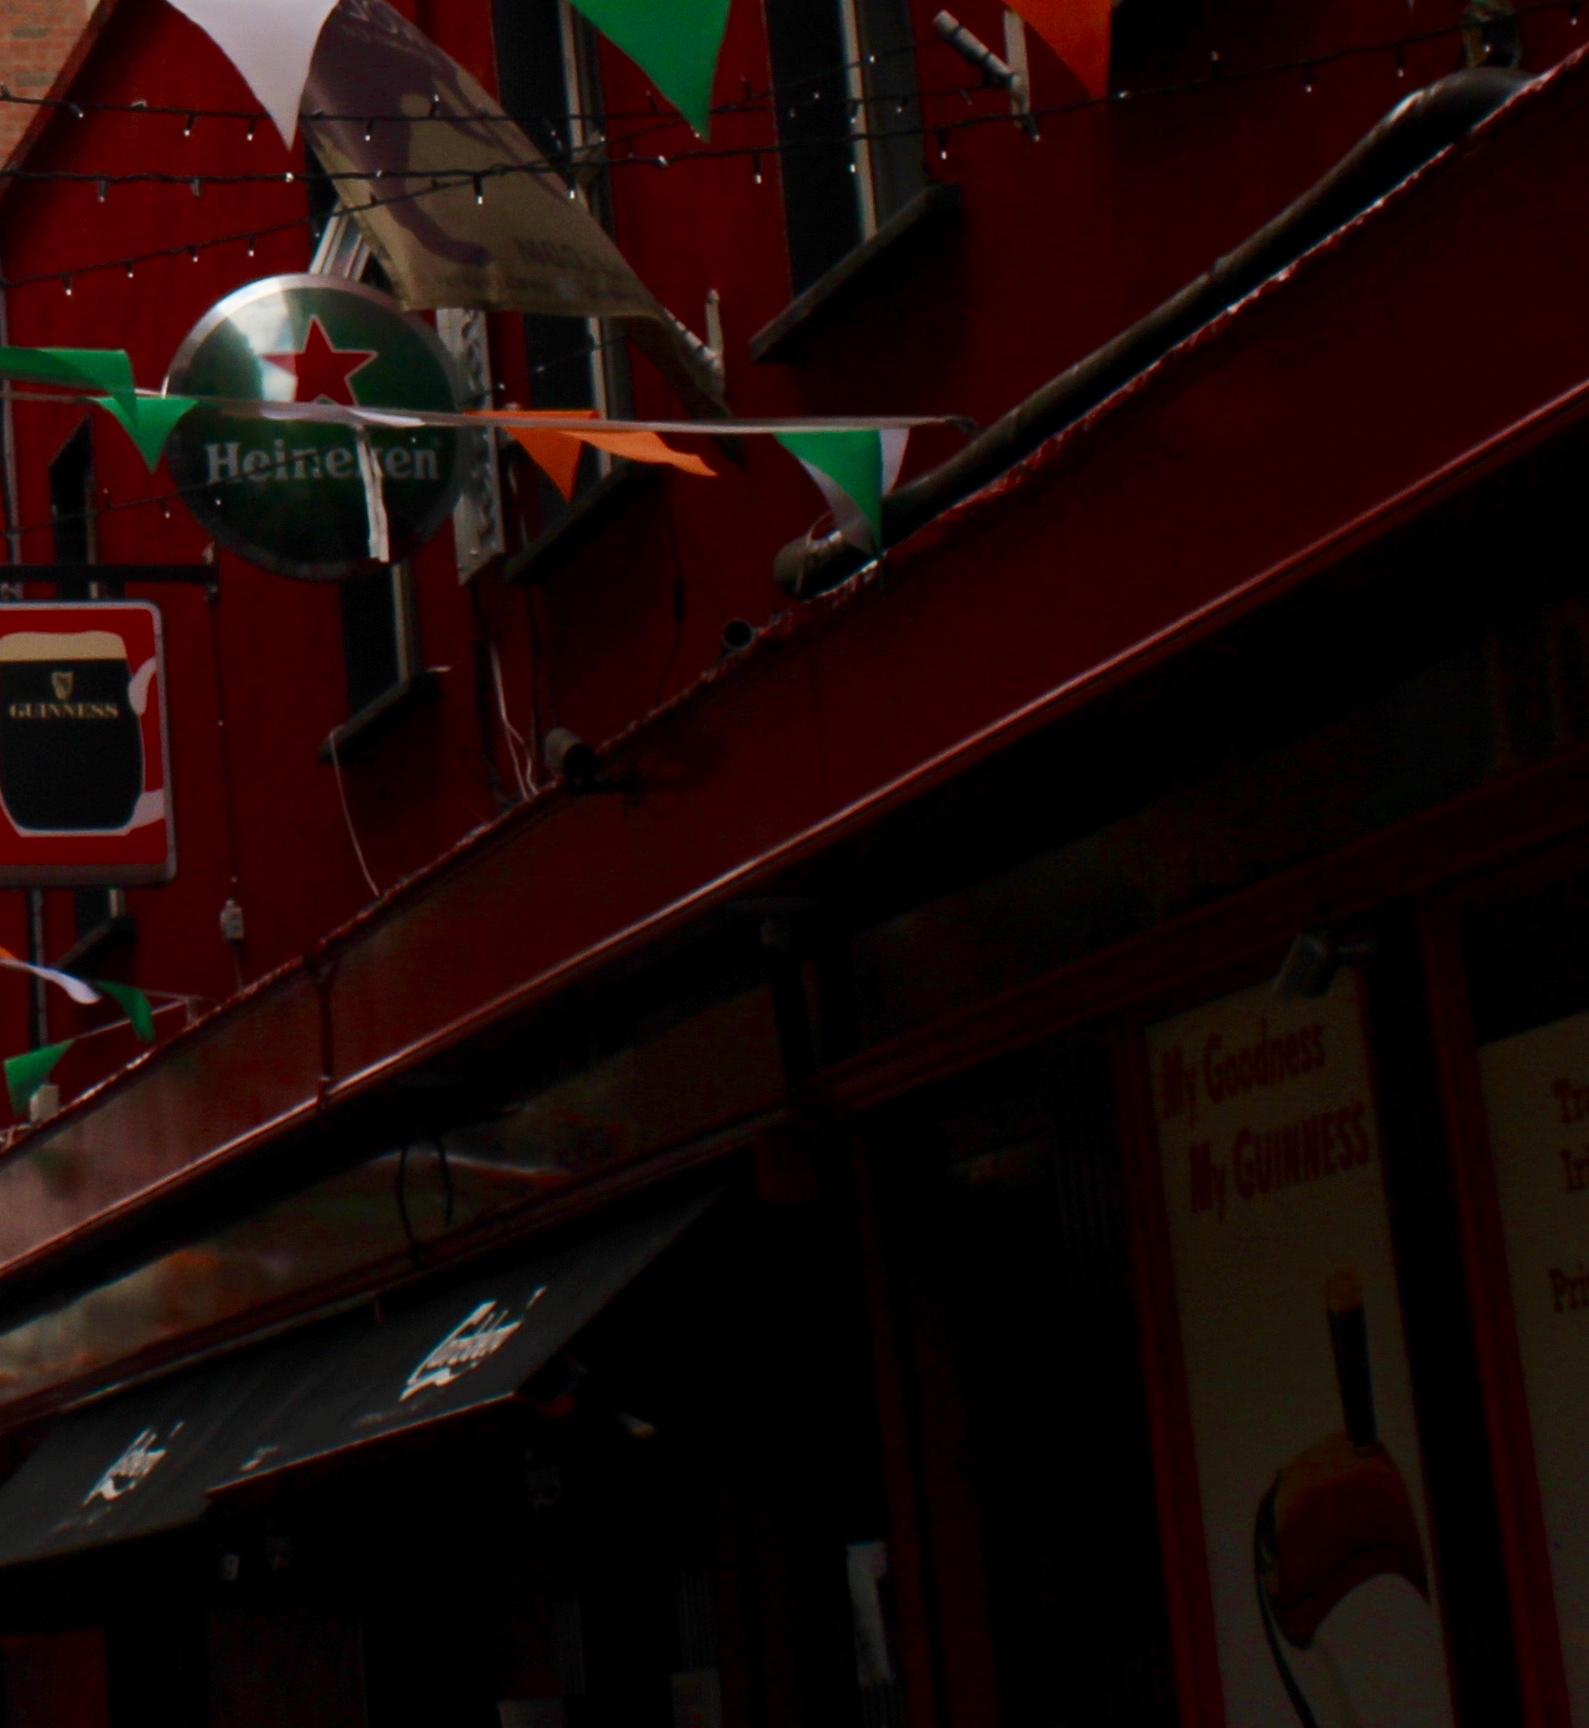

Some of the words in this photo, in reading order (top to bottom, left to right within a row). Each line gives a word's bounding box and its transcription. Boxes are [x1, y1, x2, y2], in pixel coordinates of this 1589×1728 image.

[9, 702, 122, 721] GUINNESS
[1162, 1044, 1198, 1130] My
[1204, 1018, 1325, 1104] Goodness
[1190, 1140, 1226, 1224] My
[1234, 1103, 1370, 1199] GUINNESS
